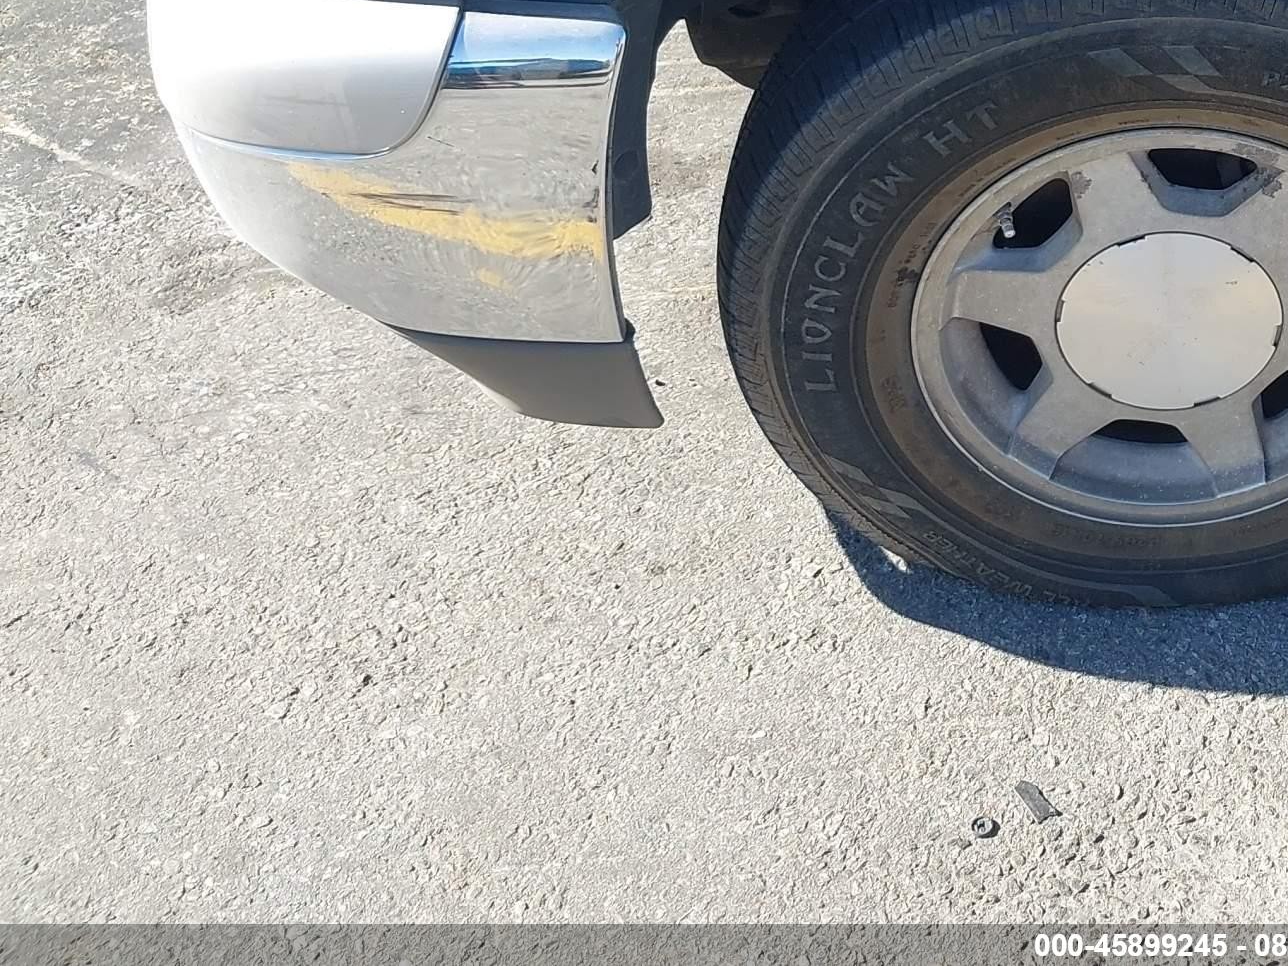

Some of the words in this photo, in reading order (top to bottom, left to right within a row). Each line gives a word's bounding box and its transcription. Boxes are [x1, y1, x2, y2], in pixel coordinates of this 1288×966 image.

[801, 161, 915, 394] LIONCLAW
[922, 102, 1001, 158] HT
[922, 529, 1034, 599] WEATHER
